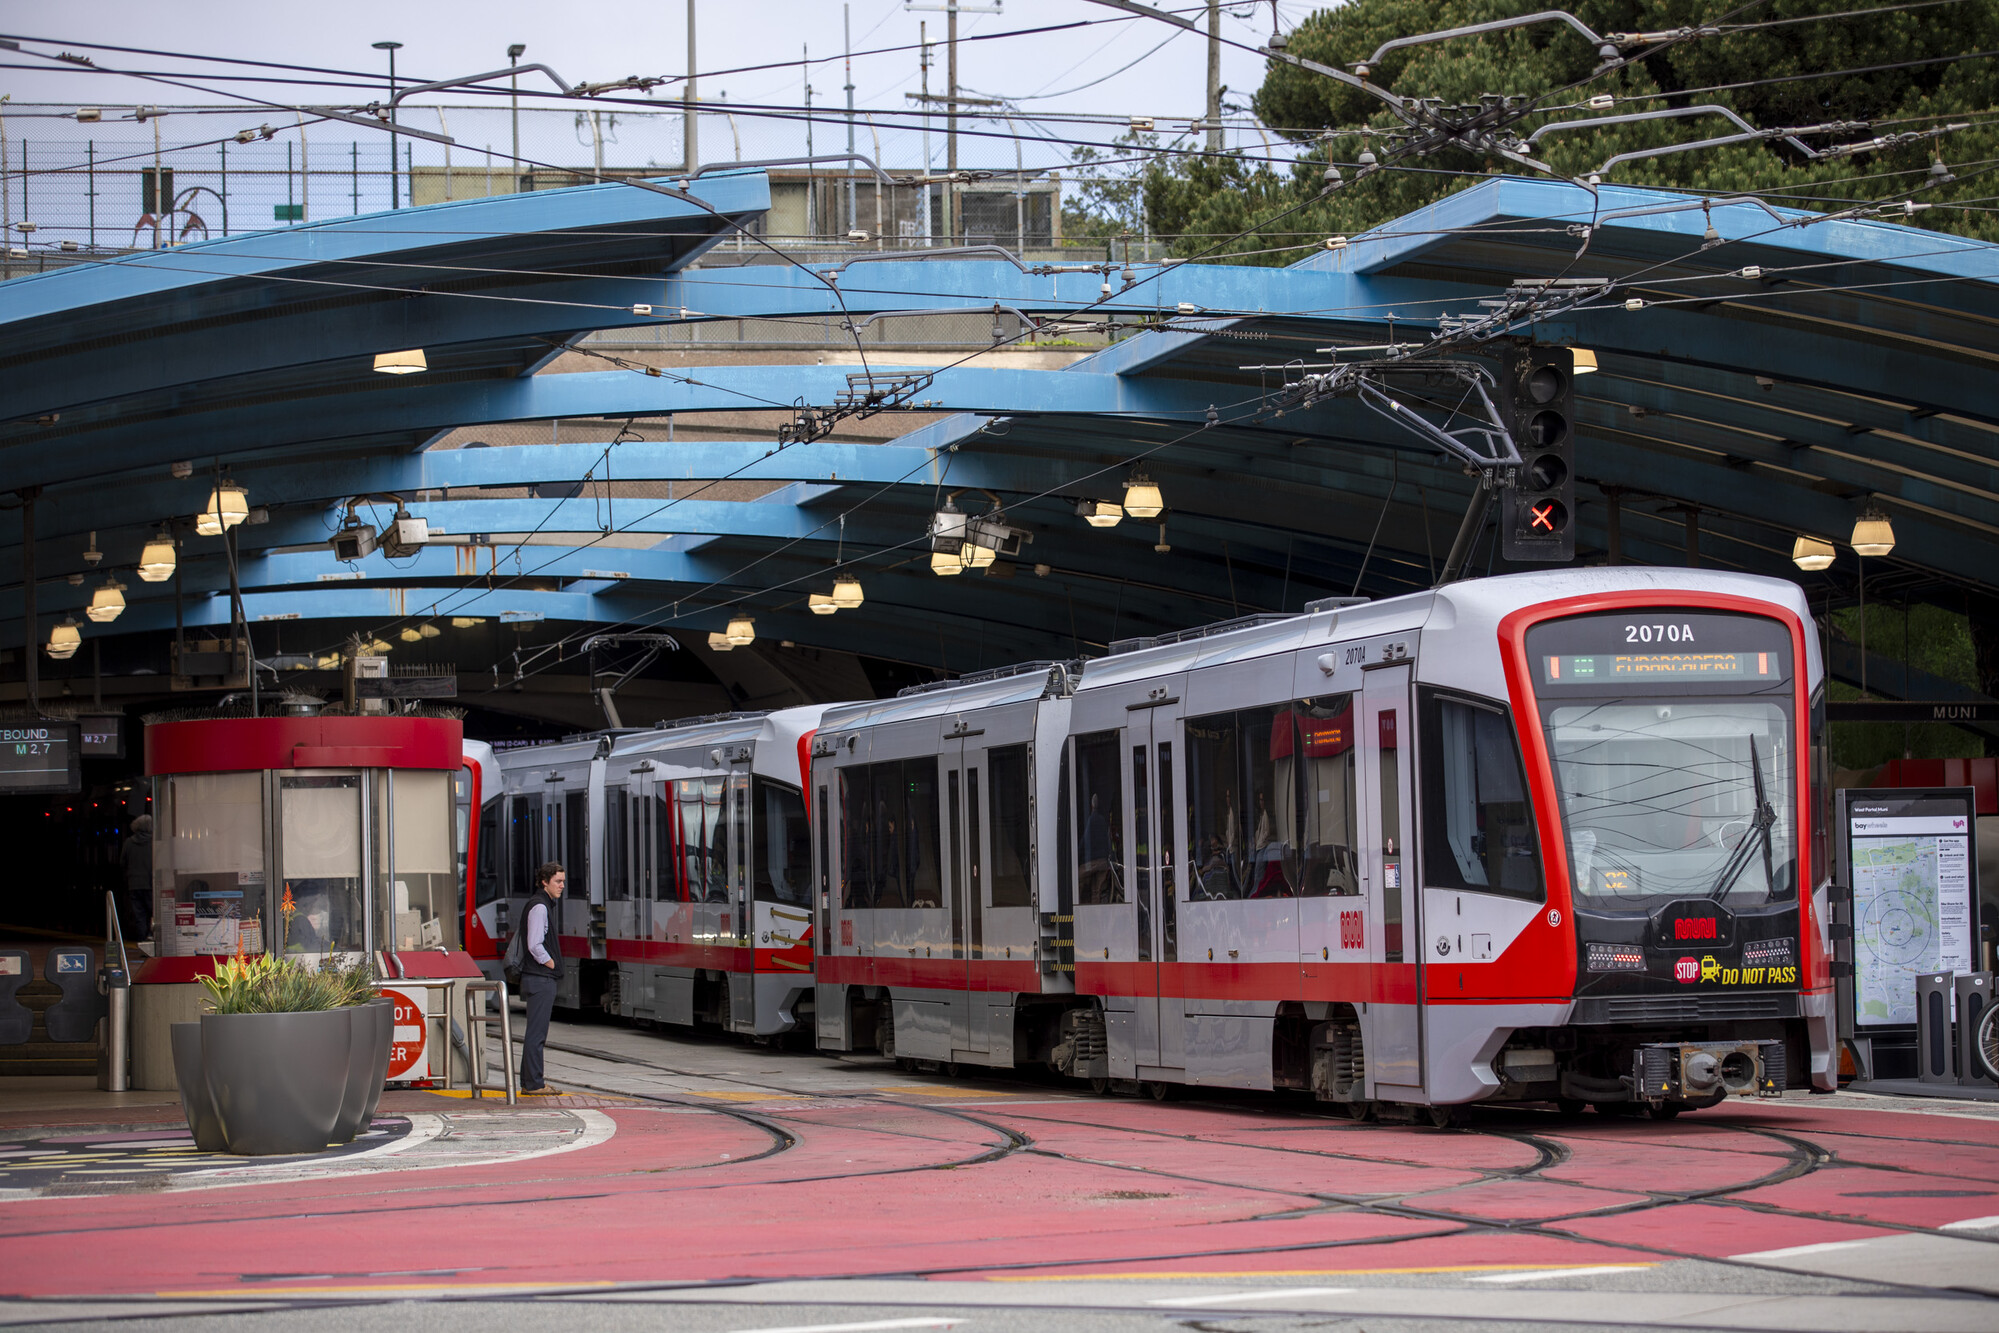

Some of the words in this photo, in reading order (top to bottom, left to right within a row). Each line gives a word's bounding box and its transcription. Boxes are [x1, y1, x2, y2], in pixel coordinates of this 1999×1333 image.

[1625, 624, 1695, 643] 2070A
[1346, 646, 1365, 665] 2070A
[1933, 705, 1977, 719] MUNI
[84, 735, 92, 743] M
[16, 744, 27, 755] M
[43, 743, 51, 754] 7
[1674, 917, 1717, 940] MUNI
[1676, 964, 1699, 979] STOP
[1722, 969, 1739, 985] DO
[1741, 968, 1766, 985] NOT
[1768, 967, 1797, 984] PASS
[394, 1006, 413, 1021] OT
[390, 1047, 407, 1061] ER
